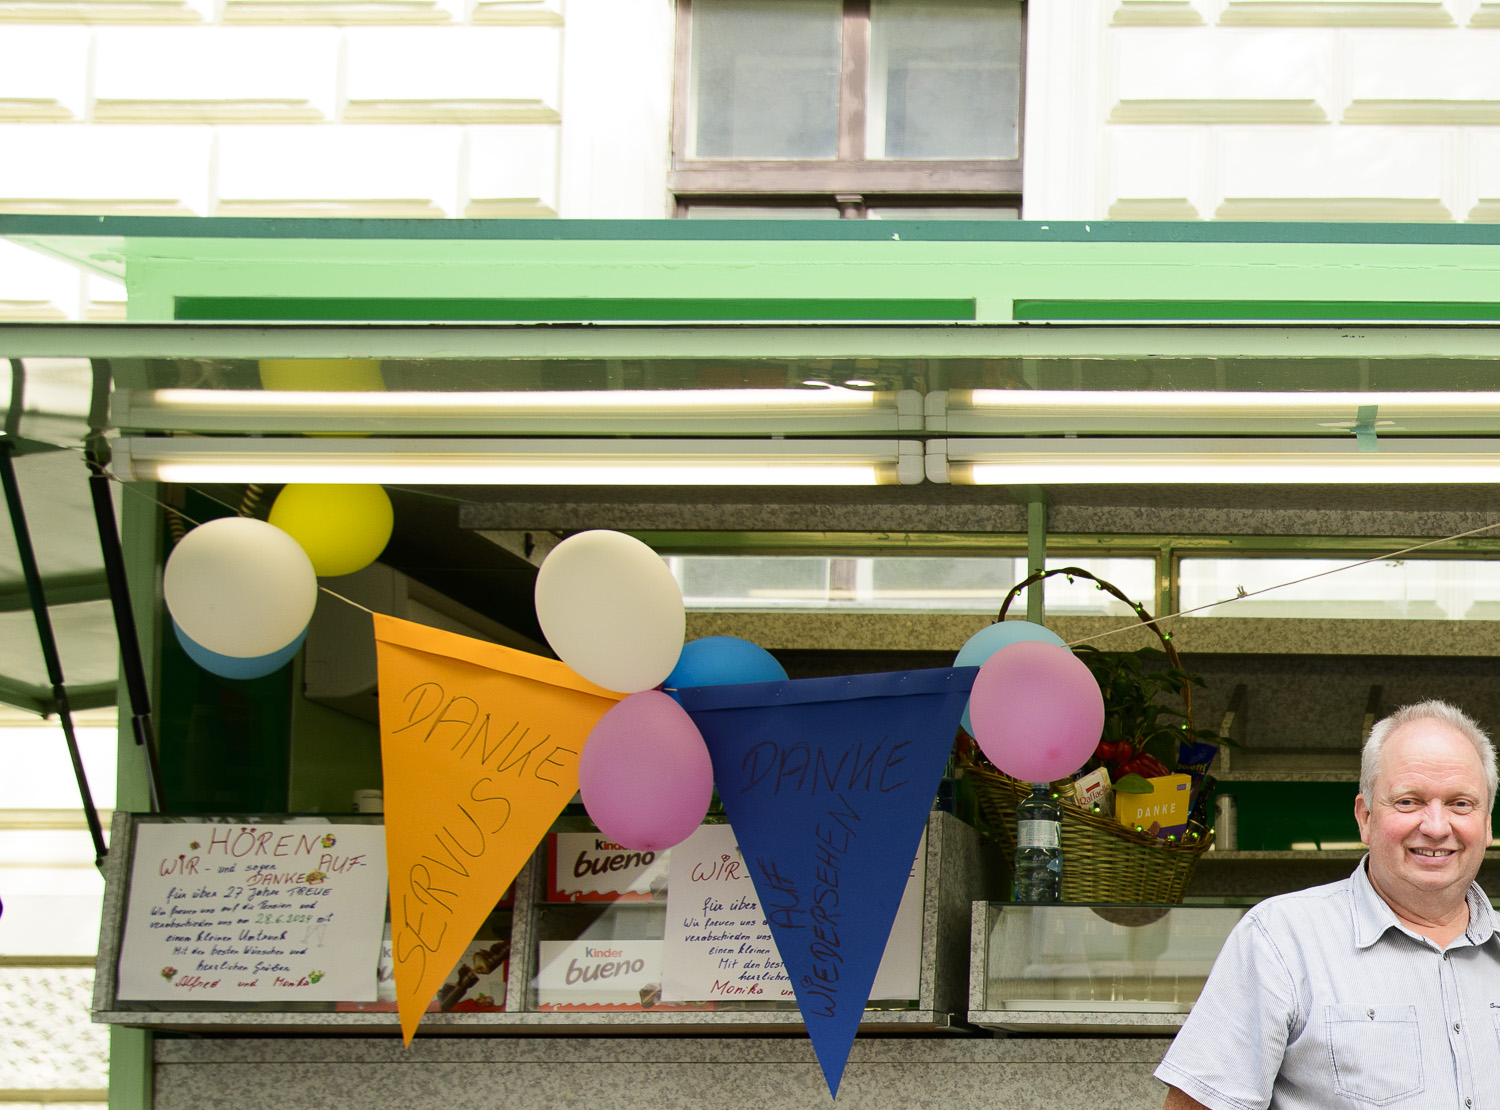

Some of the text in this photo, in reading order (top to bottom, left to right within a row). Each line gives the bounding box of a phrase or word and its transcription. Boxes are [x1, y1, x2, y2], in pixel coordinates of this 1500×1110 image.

[392, 682, 578, 787] DANKE
[740, 736, 912, 796] DANKE
[1136, 803, 1176, 819] DANKE
[207, 827, 322, 858] HÖREN
[159, 854, 200, 876] WIR
[218, 863, 239, 874] und
[573, 850, 656, 878] bueno
[691, 854, 741, 882] WIR
[246, 871, 307, 887] DANKE
[397, 777, 511, 996] SERVUS
[166, 886, 187, 904] für
[223, 886, 244, 899] 27
[286, 886, 334, 897] TREUE
[757, 857, 806, 929] AUF
[702, 896, 757, 917] für über
[801, 793, 862, 1018] WIEDERSEHEN
[683, 918, 700, 928] Wir
[704, 918, 735, 929] freuen
[685, 931, 751, 942] verabschieden
[709, 946, 735, 955] einem
[565, 959, 645, 985] bueno
[718, 958, 739, 969] Mit
[743, 959, 760, 969] den
[237, 979, 260, 987] und
[711, 979, 764, 996] Monika
